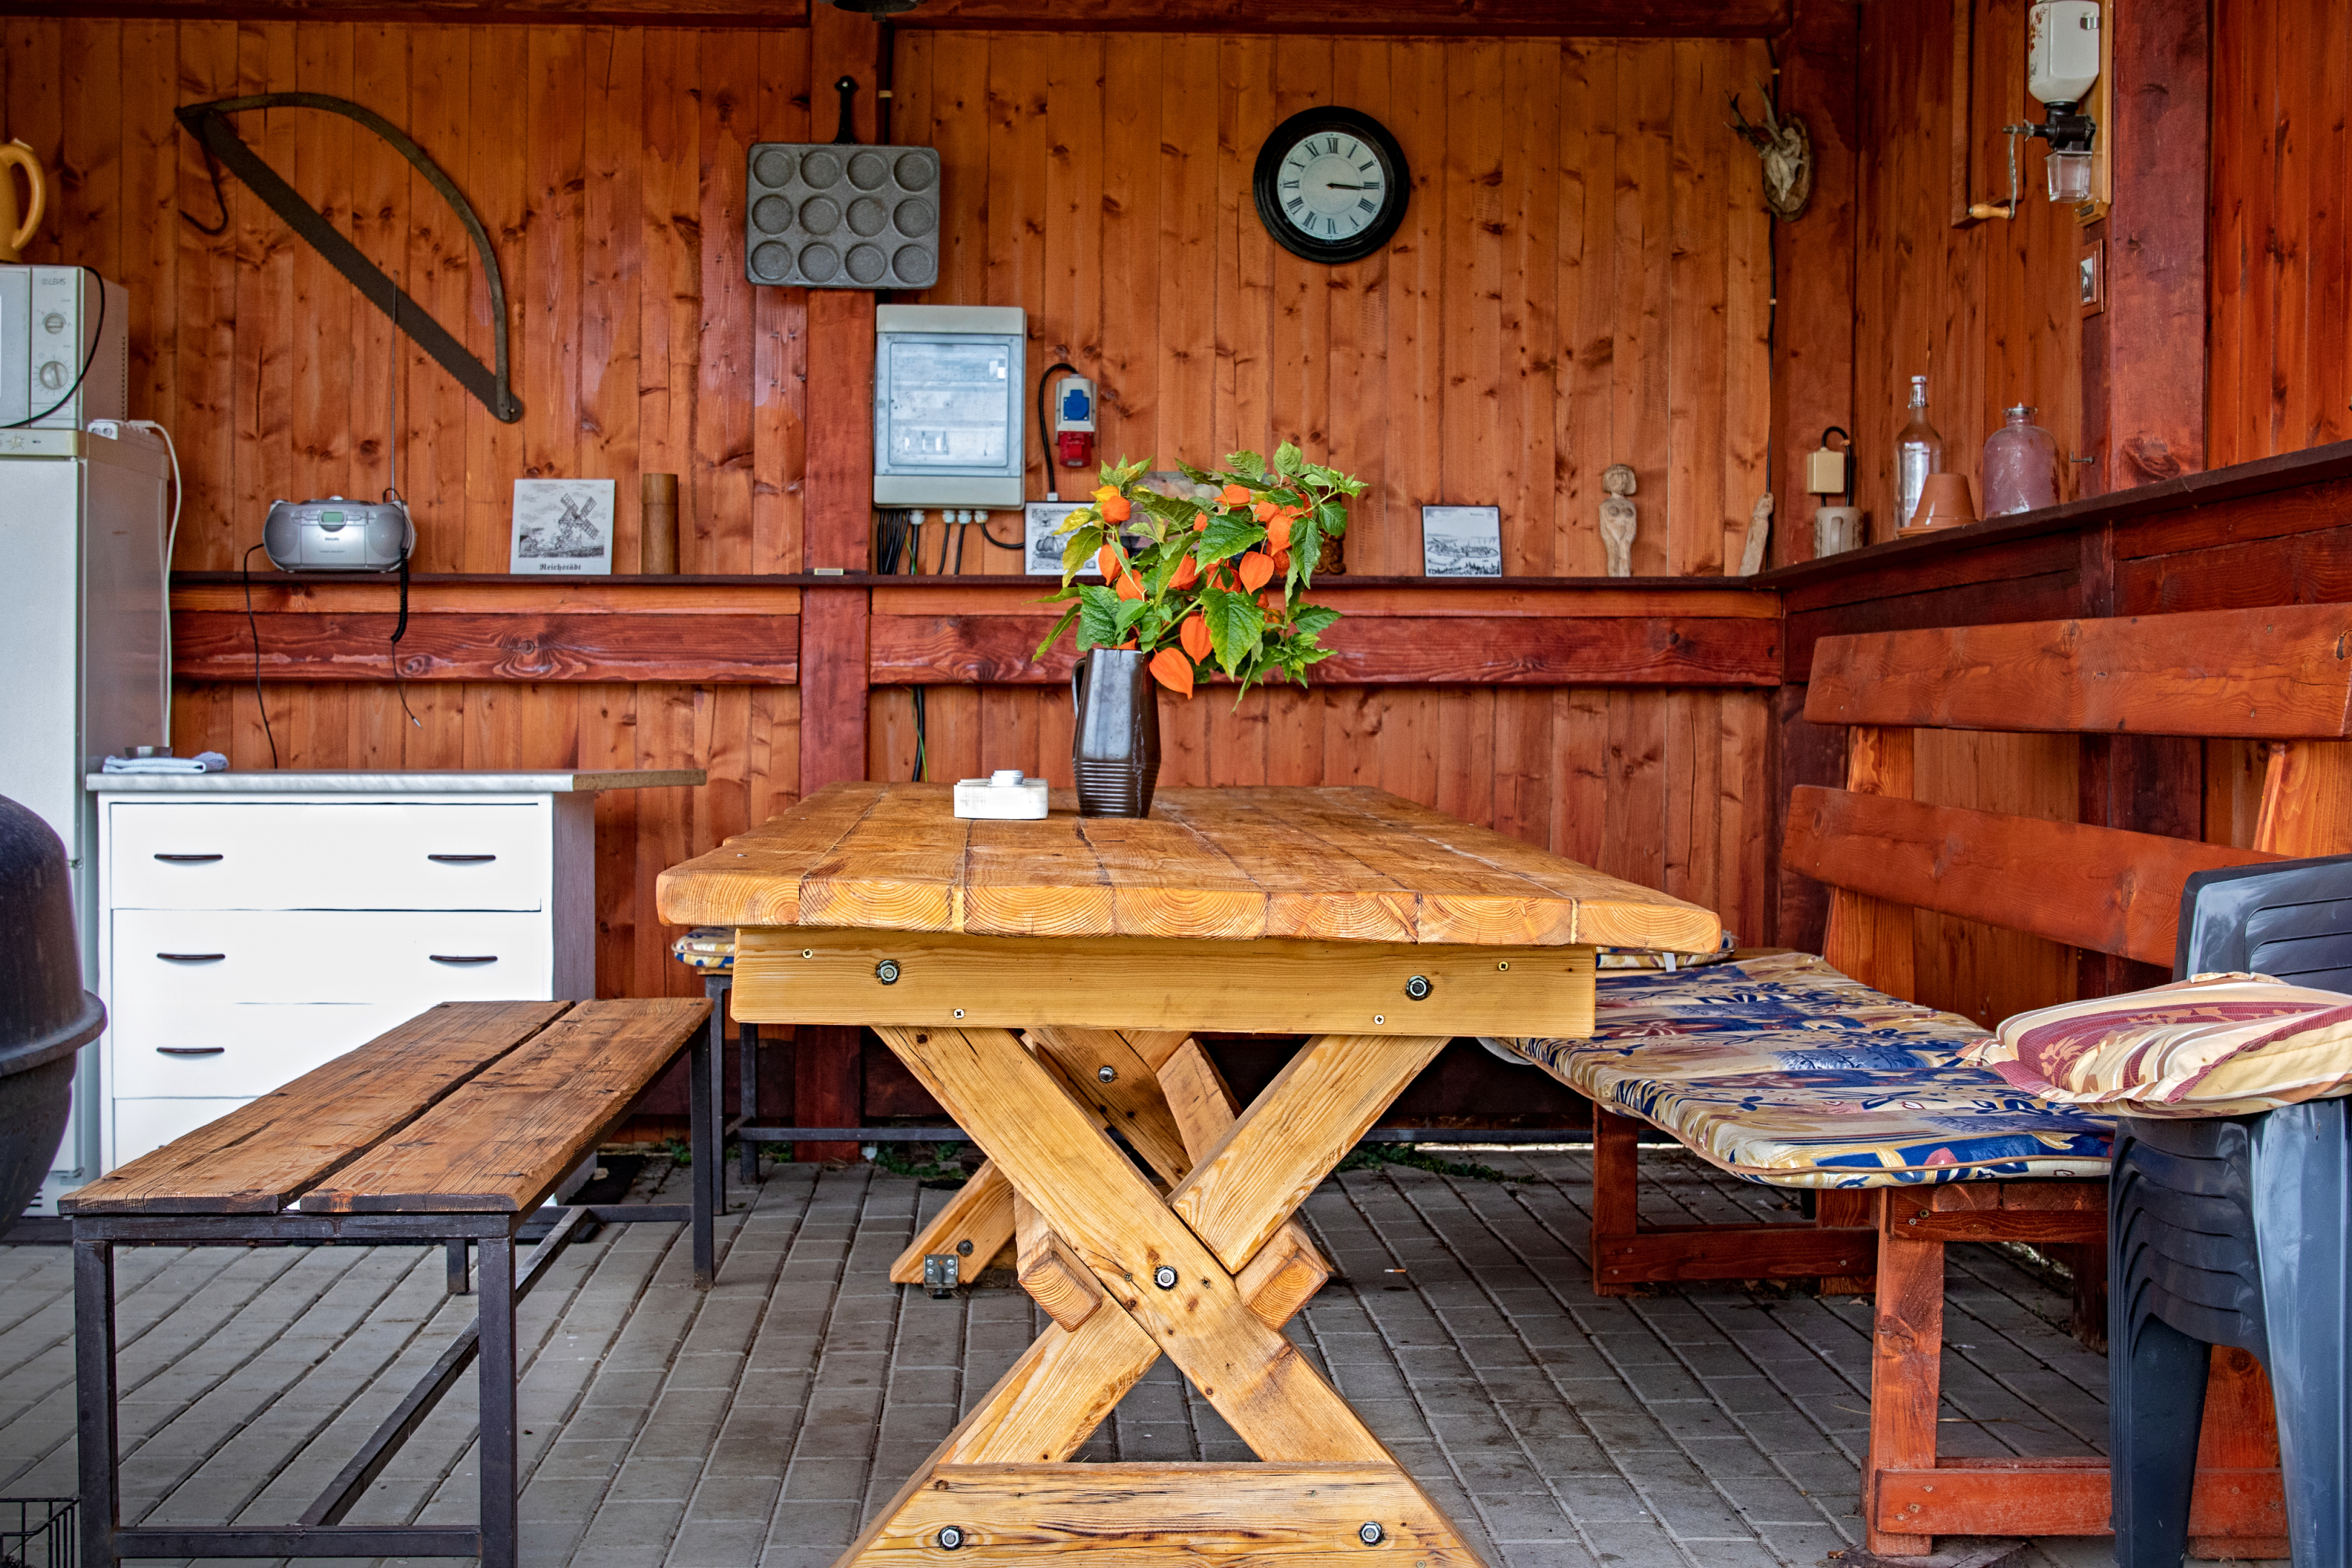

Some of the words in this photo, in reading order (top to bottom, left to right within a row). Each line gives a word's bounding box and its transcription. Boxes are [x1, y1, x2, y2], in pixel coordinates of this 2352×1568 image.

[1304, 141, 1321, 160] XI
[1326, 137, 1339, 154] XII
[1347, 144, 1358, 159] I
[1289, 158, 1305, 173] X
[1358, 160, 1375, 173] II
[1283, 178, 1299, 189] IX
[1287, 196, 1304, 216] VIII
[1303, 211, 1317, 230] VII
[1326, 218, 1337, 234] VI
[1349, 215, 1360, 229] V
[539, 563, 581, 572] Reichstädt
